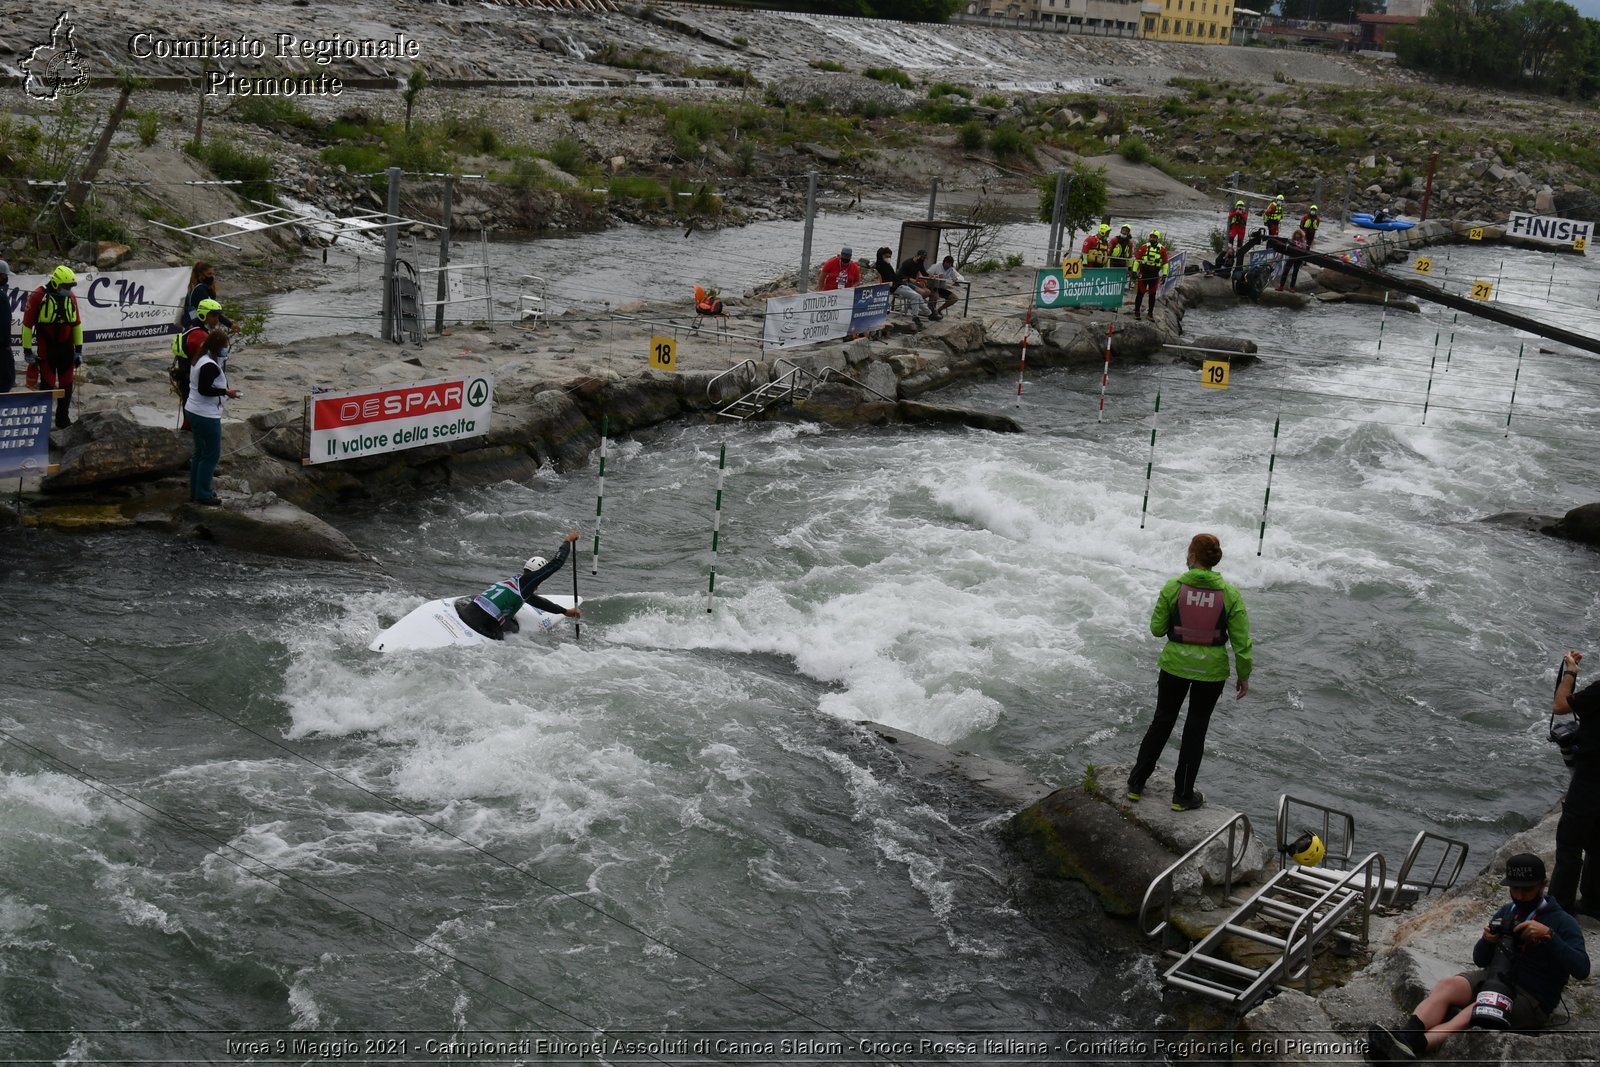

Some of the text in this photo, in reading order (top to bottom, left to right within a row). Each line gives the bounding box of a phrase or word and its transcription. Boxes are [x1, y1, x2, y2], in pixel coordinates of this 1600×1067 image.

[1471, 230, 1481, 239] 24
[1513, 215, 1588, 242] FINISH
[1575, 241, 1584, 249] 25
[1065, 262, 1079, 275] 20
[1416, 261, 1430, 272] 22
[1063, 275, 1124, 300] Raspini Salumi
[1474, 284, 1490, 298] 21
[828, 294, 838, 307] PER
[120, 304, 161, 322] Service
[95, 324, 169, 340] www.cmservicesrl.it
[803, 324, 830, 340] SPORTIVO
[655, 343, 671, 365] 18
[1208, 365, 1224, 383] 19
[1, 405, 48, 417] CANOE
[340, 386, 462, 421] DESPAR
[0, 415, 43, 427] LALOM
[3, 427, 39, 438] PEAN
[342, 434, 388, 454] valore
[393, 426, 429, 445] della
[432, 417, 475, 437] scelta
[481, 584, 505, 600] 21
[1186, 590, 1215, 608] HH
